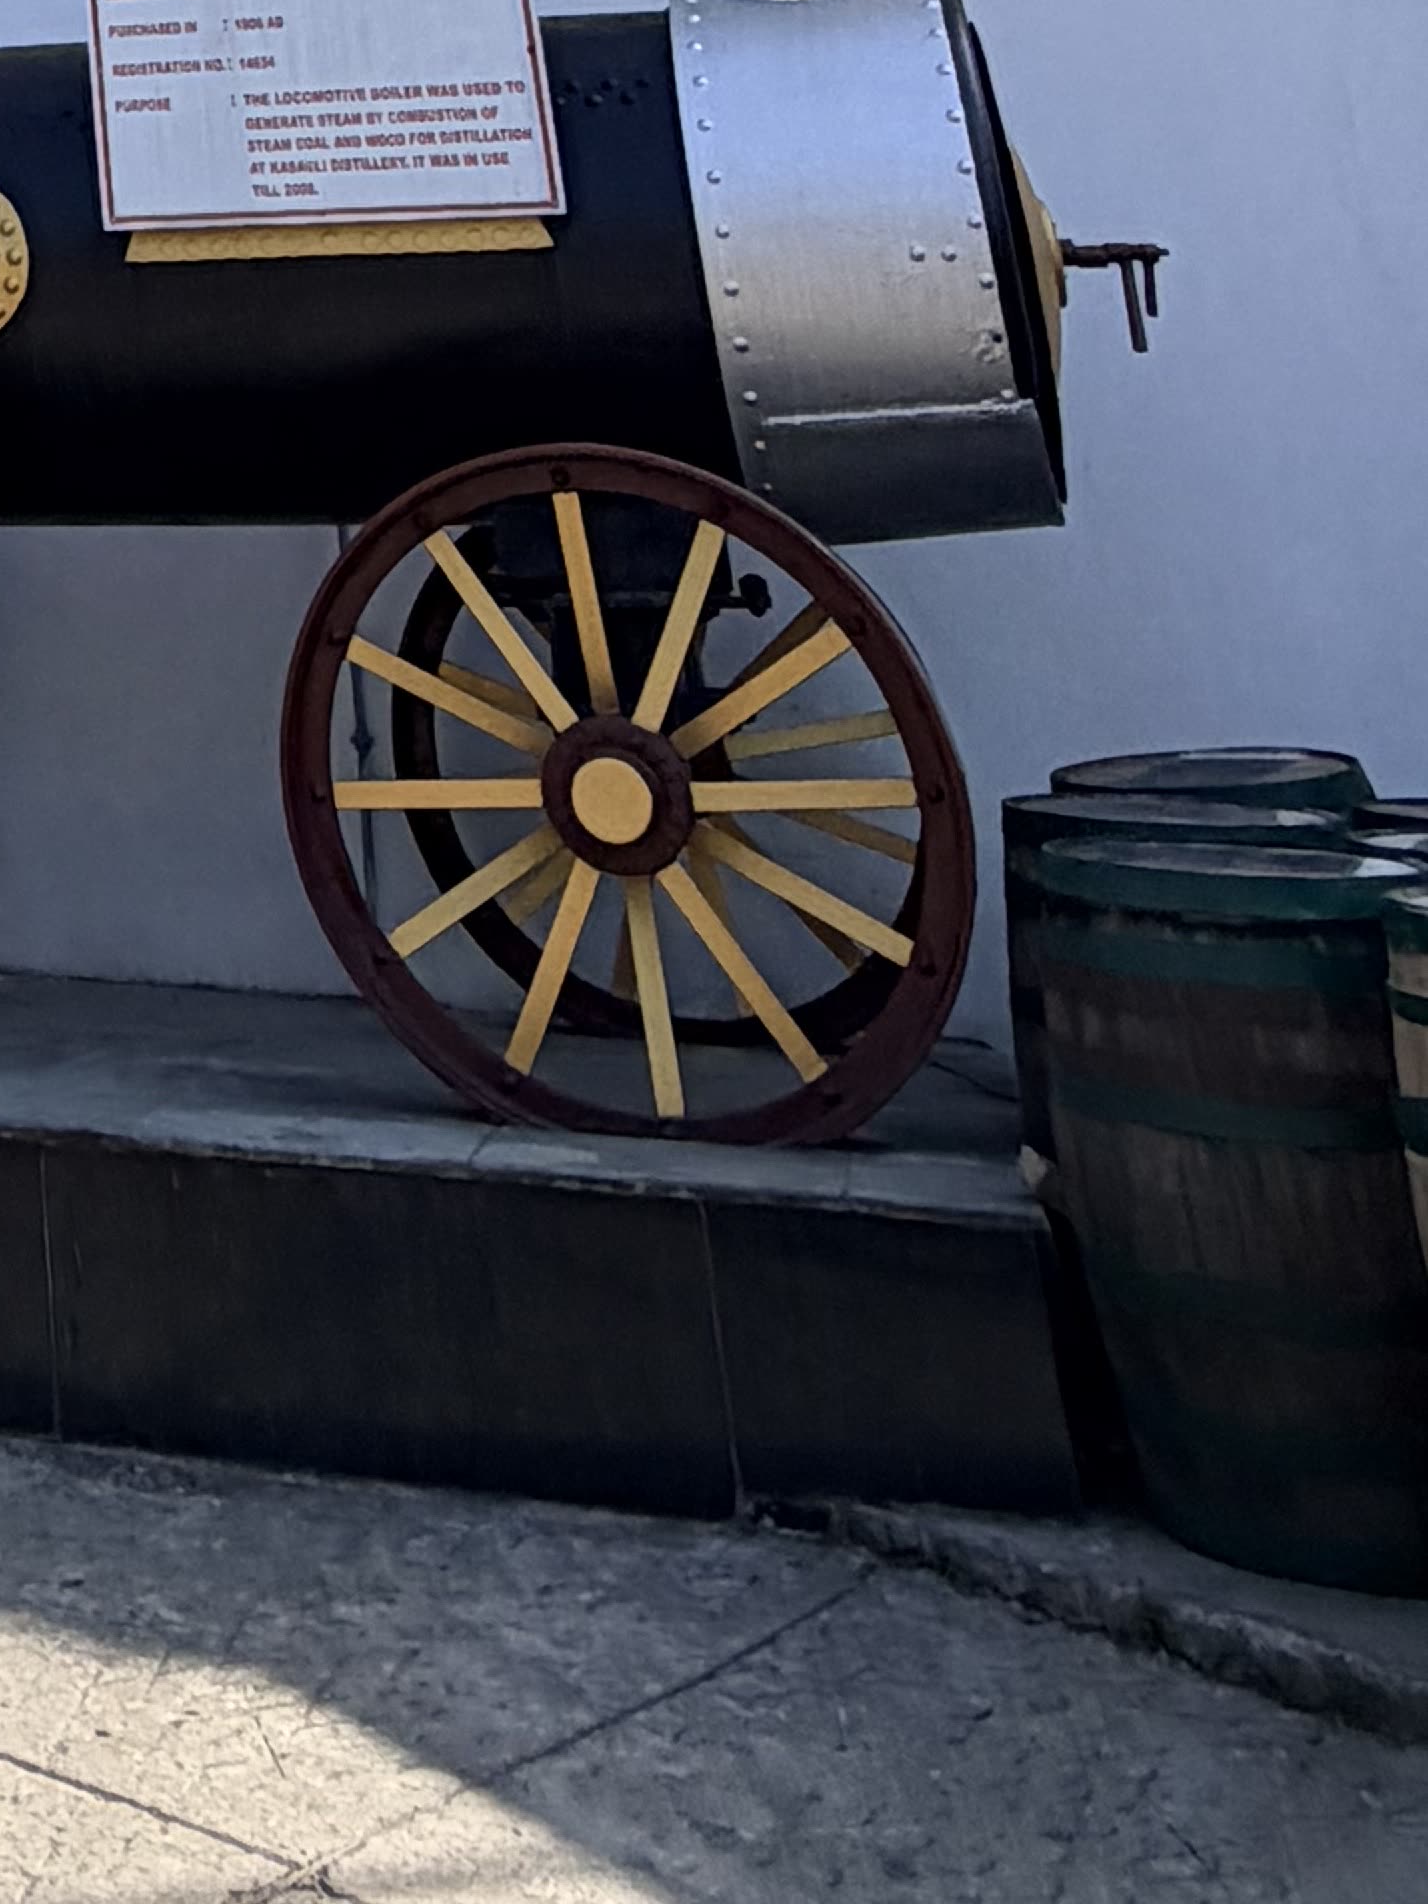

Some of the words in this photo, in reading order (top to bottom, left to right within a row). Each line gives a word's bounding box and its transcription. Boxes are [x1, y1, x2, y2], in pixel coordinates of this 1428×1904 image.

[109, 21, 182, 38] PURCHASED
[112, 59, 202, 76] REGISTRATION
[115, 98, 172, 112] PURPOSE
[244, 93, 272, 106] THE
[274, 88, 367, 105] LOCOMOTIVE
[370, 85, 423, 101] BOILER
[425, 83, 460, 98] WAS
[462, 81, 502, 97] USED
[504, 80, 526, 94] TO
[245, 114, 314, 130] GENERATE
[317, 112, 363, 128] STEAM
[366, 111, 384, 125] BY
[388, 107, 479, 125] COMBUSTION
[481, 106, 499, 120] OF
[247, 138, 292, 153] STEAM
[296, 136, 331, 150] COAL
[334, 135, 362, 149] AND
[408, 132, 437, 146] FOR
[439, 128, 532, 144] DISTILLATION
[249, 162, 266, 175] AT
[412, 155, 426, 168] IT
[429, 154, 460, 168] WAS
[463, 153, 479, 166] IN
[481, 152, 510, 165] USE
[251, 184, 281, 197] TILL
